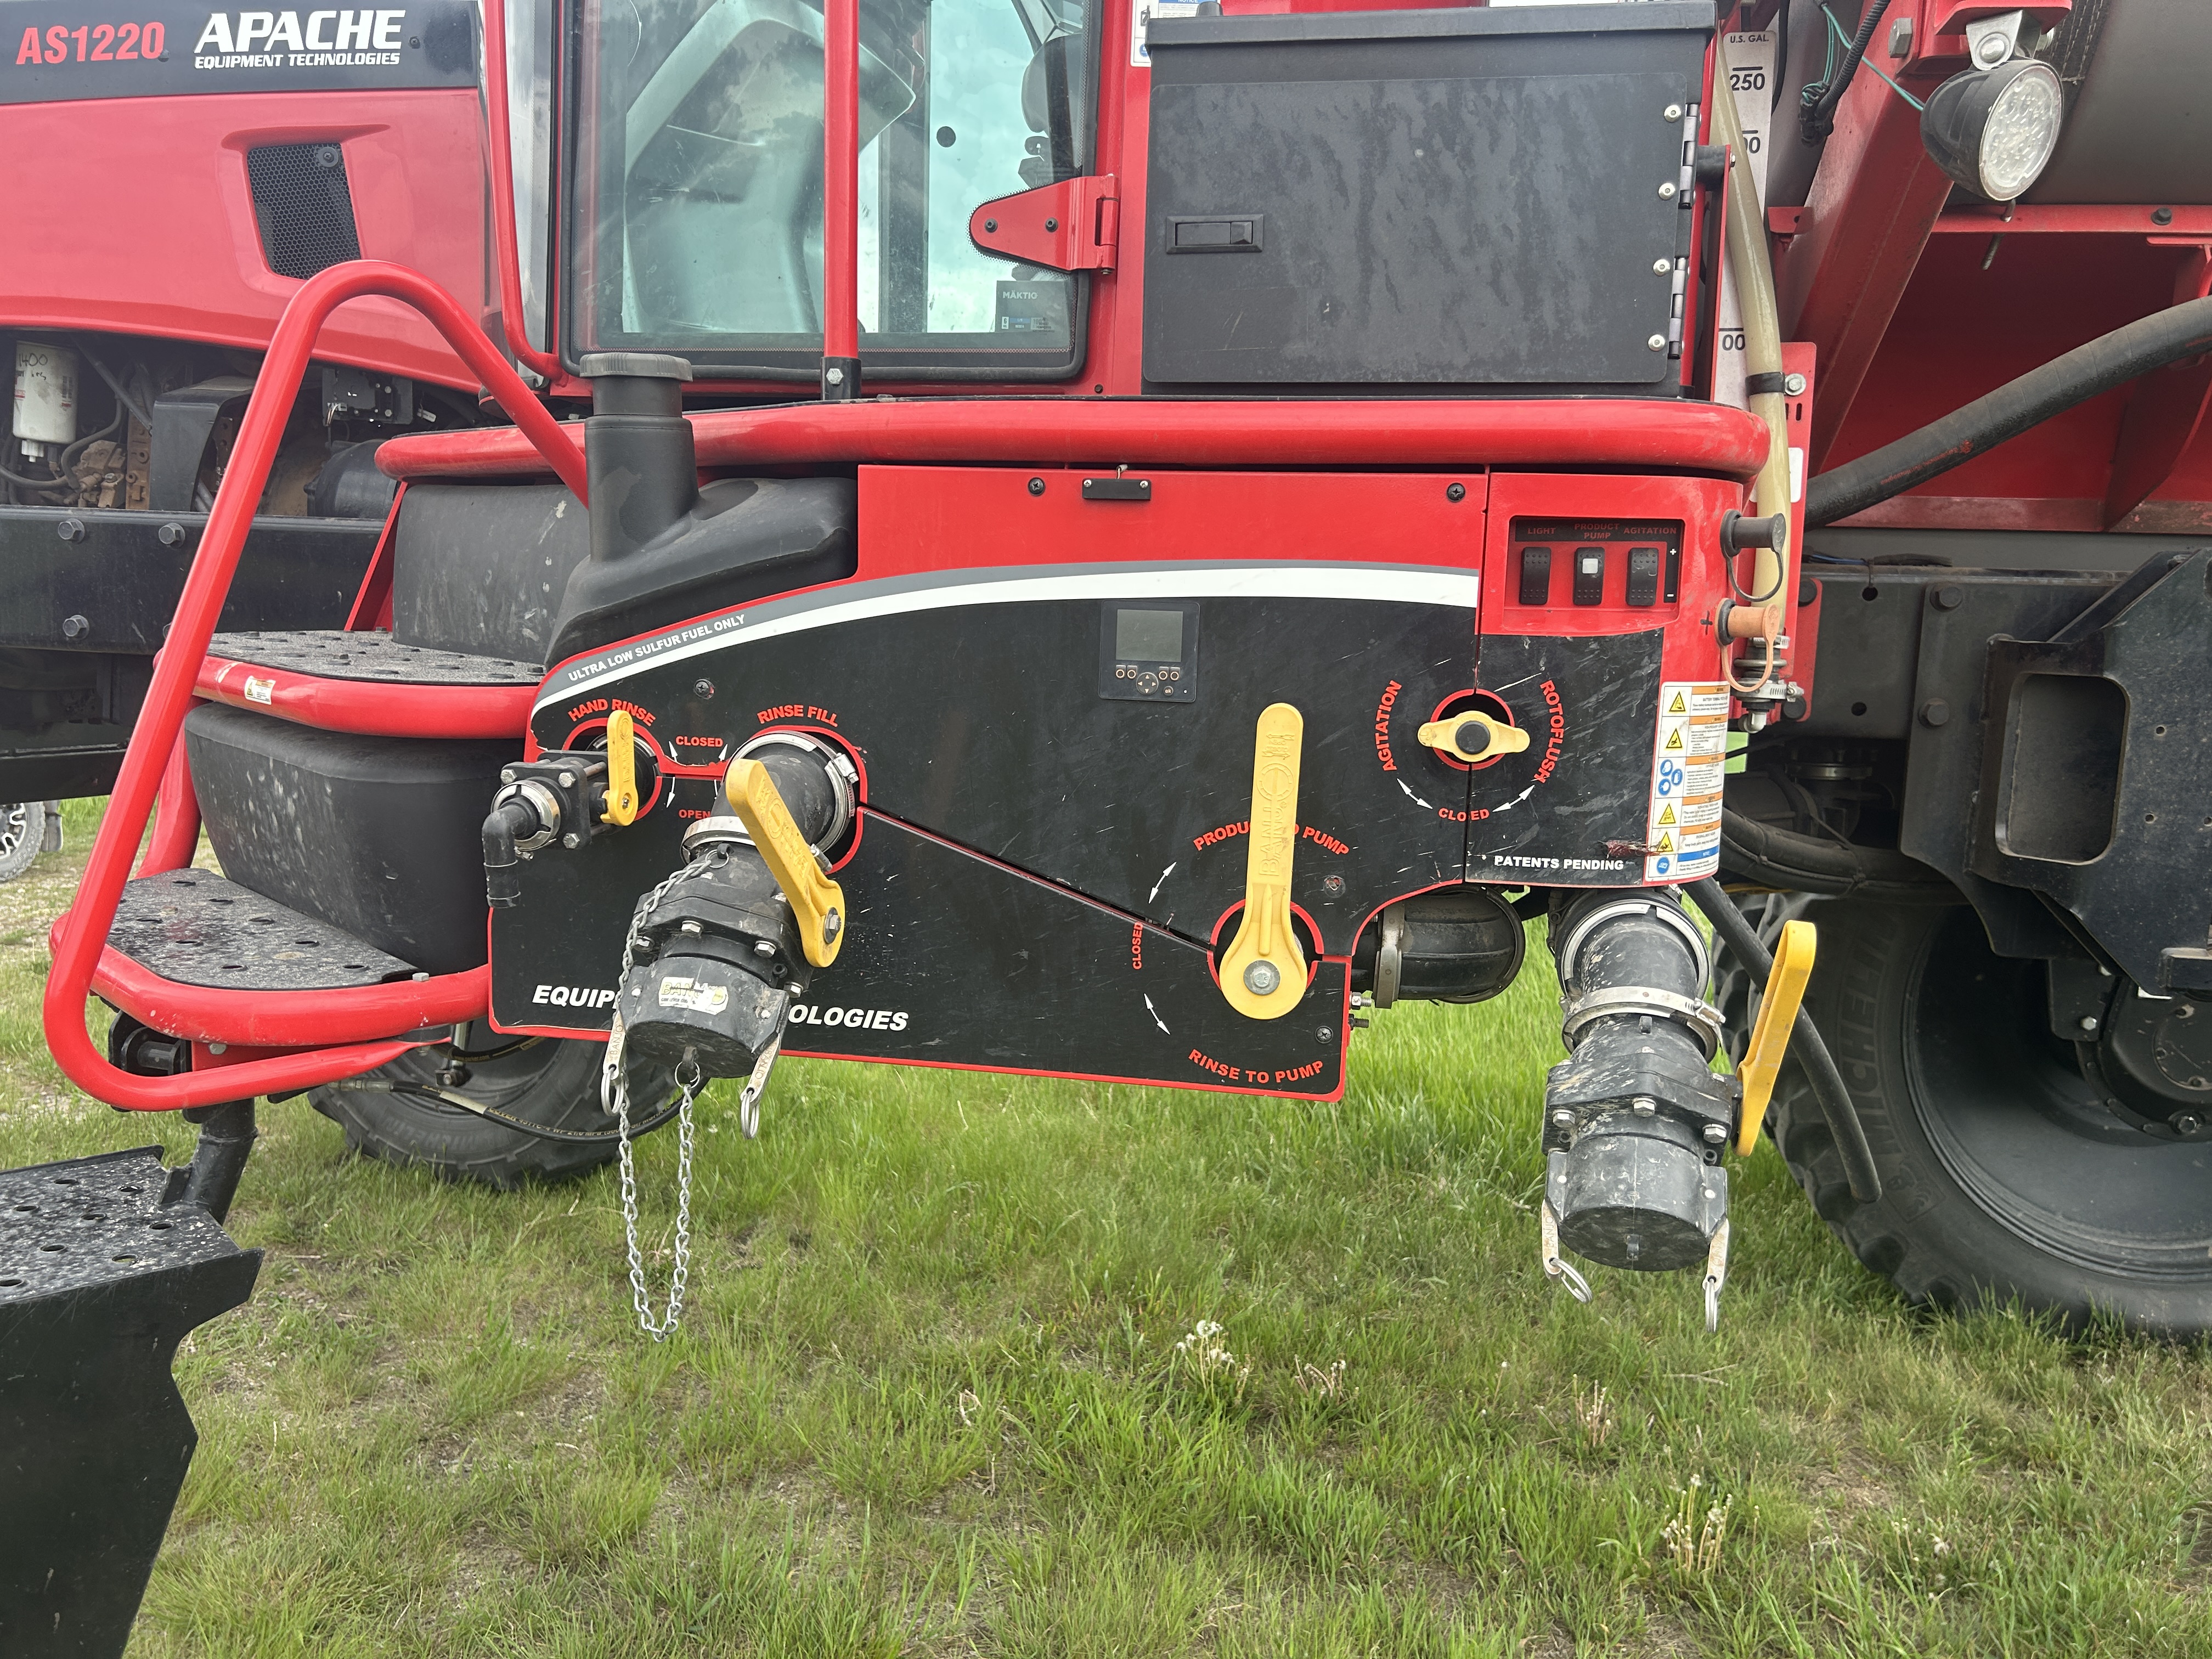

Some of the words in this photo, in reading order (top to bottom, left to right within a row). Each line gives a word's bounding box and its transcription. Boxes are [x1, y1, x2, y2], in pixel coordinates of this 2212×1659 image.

[16, 22, 165, 65] AS1220
[194, 9, 406, 53] APACHE
[1730, 35, 1746, 43] U.S.
[195, 54, 283, 70] EQUIPMENT
[288, 53, 400, 66] TECHNOLOGIES
[1730, 73, 1765, 91] 250
[19, 353, 48, 367] 1400
[1623, 527, 1677, 535] AGITATION
[568, 661, 607, 682] ULTRA
[607, 650, 633, 668] LOW
[635, 636, 681, 658] SULFUR
[681, 626, 713, 643] FUEL
[714, 614, 745, 632] ONLY
[568, 698, 608, 721] HAND
[611, 698, 656, 726] RINSE
[757, 704, 804, 725] RINSE
[808, 706, 838, 727] FILL
[1375, 680, 1402, 772] AGITATION
[675, 736, 723, 748] CLOSED
[1534, 680, 1565, 783] ROTOFLUSH
[1193, 821, 1251, 851] PRODU
[1302, 826, 1350, 855] PUMP
[1494, 855, 1560, 869] PATENTS
[1563, 859, 1624, 871] PENDING
[1132, 922, 1143, 970] CLOSED
[532, 985, 617, 1009] EQUIP
[609, 1024, 624, 1056] BANJO
[1188, 1049, 1240, 1080] RINSE
[1245, 1070, 1269, 1084] TO
[1275, 1060, 1323, 1083] PUMP
[1543, 1216, 1555, 1249] BANJO
